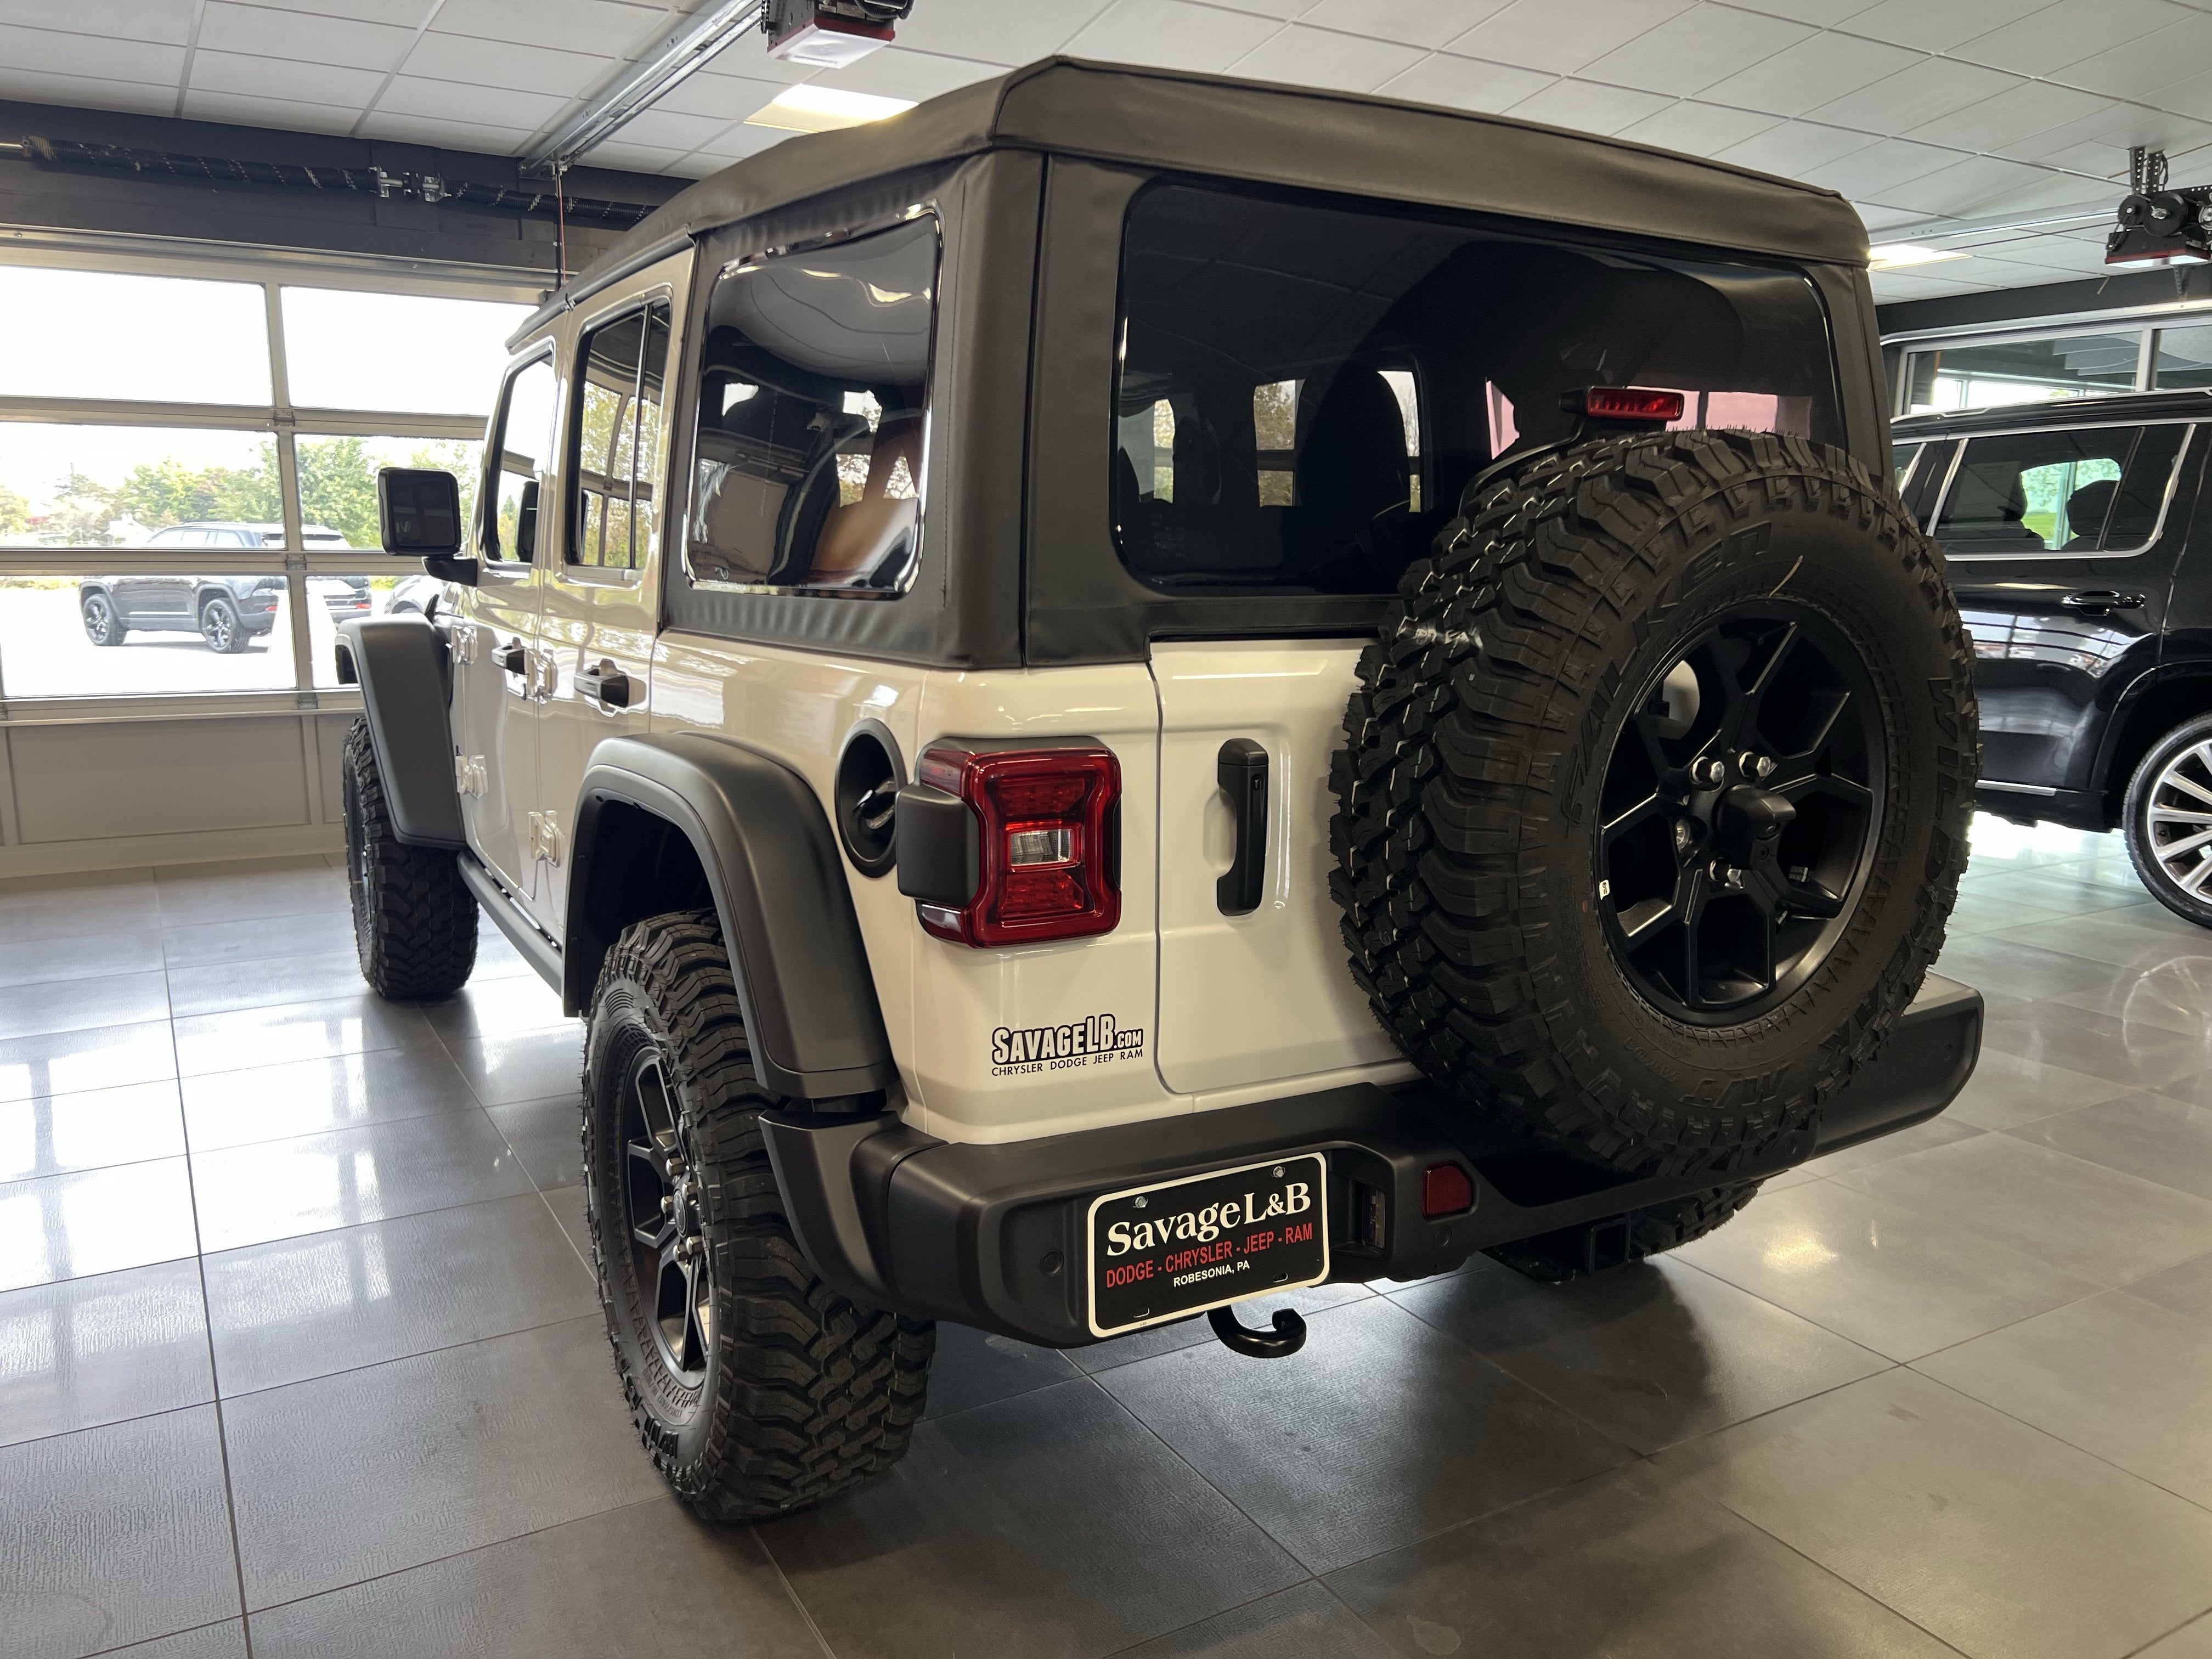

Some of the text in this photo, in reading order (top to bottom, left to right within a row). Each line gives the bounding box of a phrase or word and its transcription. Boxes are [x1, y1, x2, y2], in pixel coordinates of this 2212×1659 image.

[991, 1048, 1143, 1076] CHRYSLER DODGE JEEP RAM
[1107, 1182, 1311, 1256] Savage L&B
[1106, 1260, 1154, 1289] DODGE
[1165, 1240, 1233, 1273] CHRYSLER
[1243, 1231, 1274, 1254] JEEP
[1285, 1222, 1313, 1245] RAM
[1173, 1260, 1250, 1288] ROBESONIA, PA
